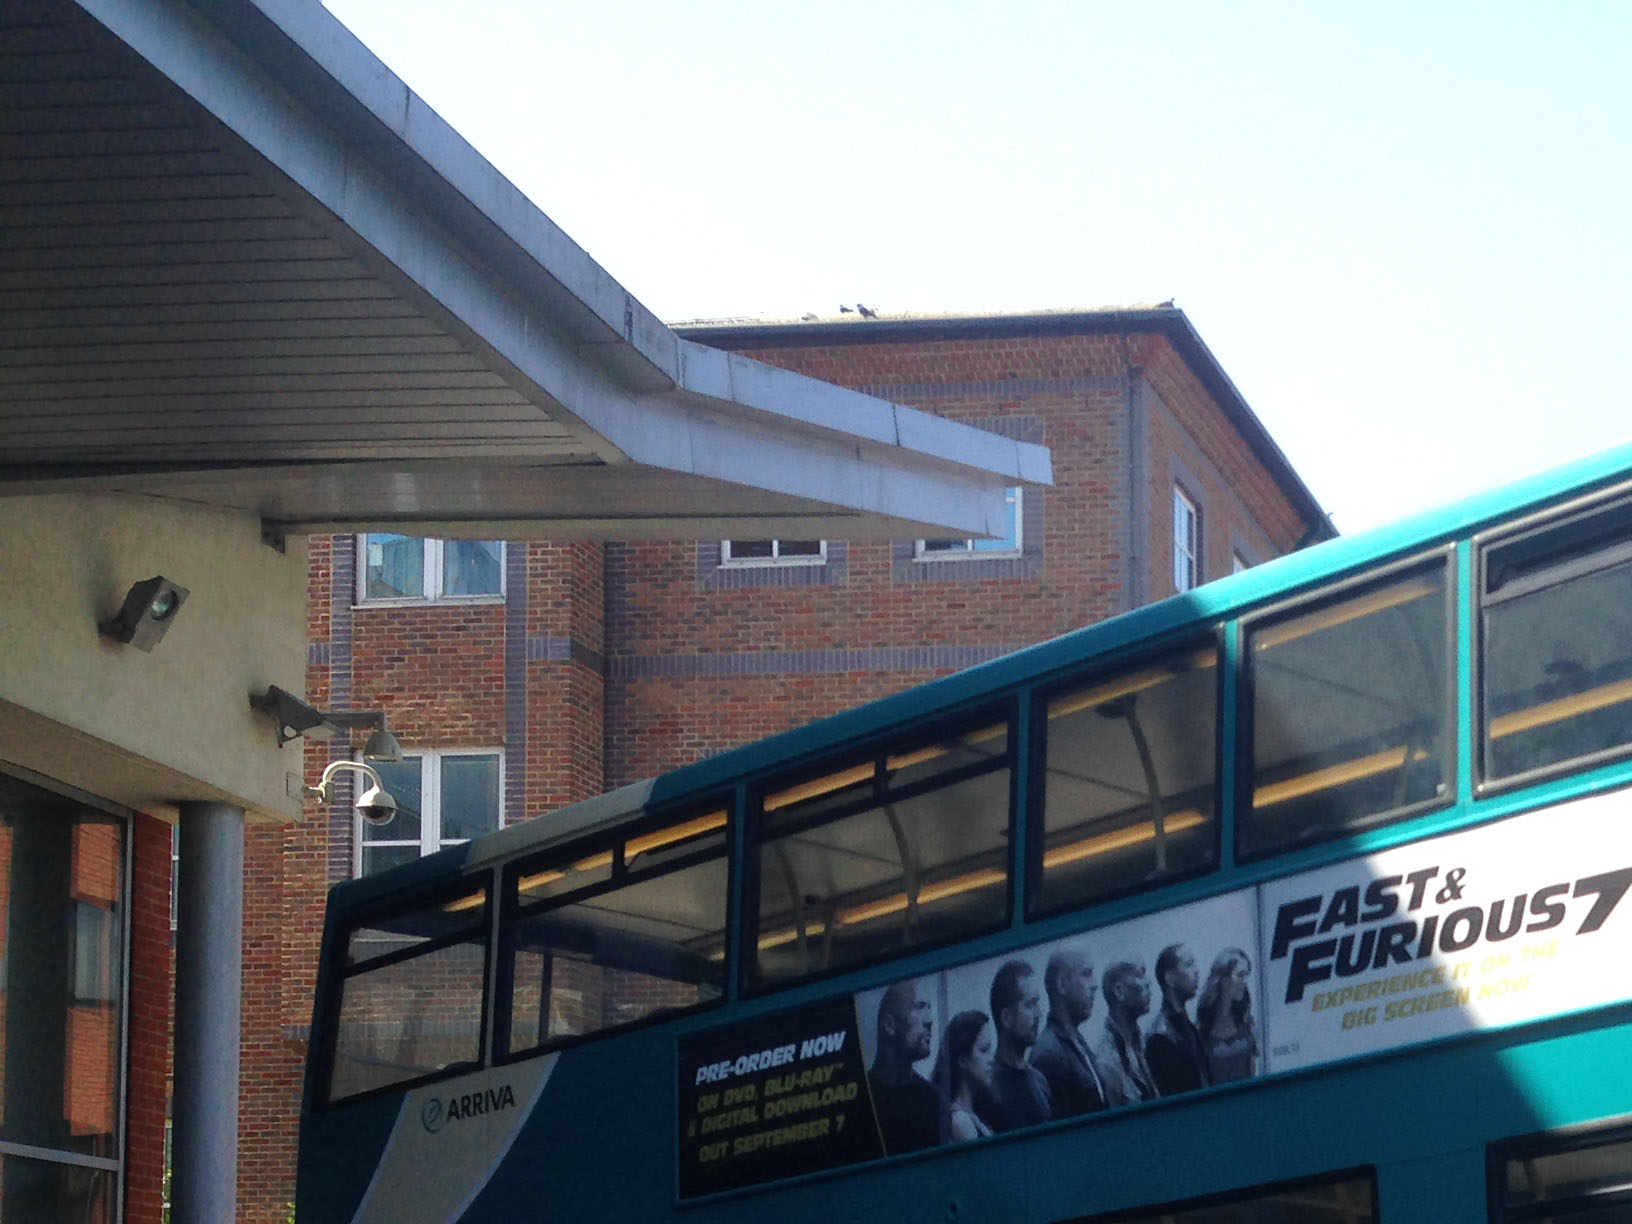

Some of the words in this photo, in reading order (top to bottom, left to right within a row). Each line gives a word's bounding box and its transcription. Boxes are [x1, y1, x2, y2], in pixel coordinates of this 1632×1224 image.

[1270, 866, 1440, 959] FAST
[1435, 867, 1467, 905] &
[1311, 966, 1448, 1012] EXPERIENCE
[1452, 960, 1473, 981] IT
[1481, 952, 1511, 975] ON
[1521, 940, 1561, 962] THE
[1342, 1007, 1378, 1031] BIG
[1384, 988, 1470, 1023] SCREEN
[1478, 975, 1532, 1001] NOW
[696, 1044, 797, 1086] PRE-ORDER
[800, 1031, 847, 1060] NOW
[446, 1085, 516, 1122] ARRIVA
[697, 1093, 720, 1113] ON
[701, 1106, 760, 1135] DIGITAL
[764, 1082, 859, 1119] DOWNLOAD
[699, 1141, 729, 1163] OUT
[733, 1118, 831, 1155] SEPTEMBER
[835, 1115, 846, 1132] 7
